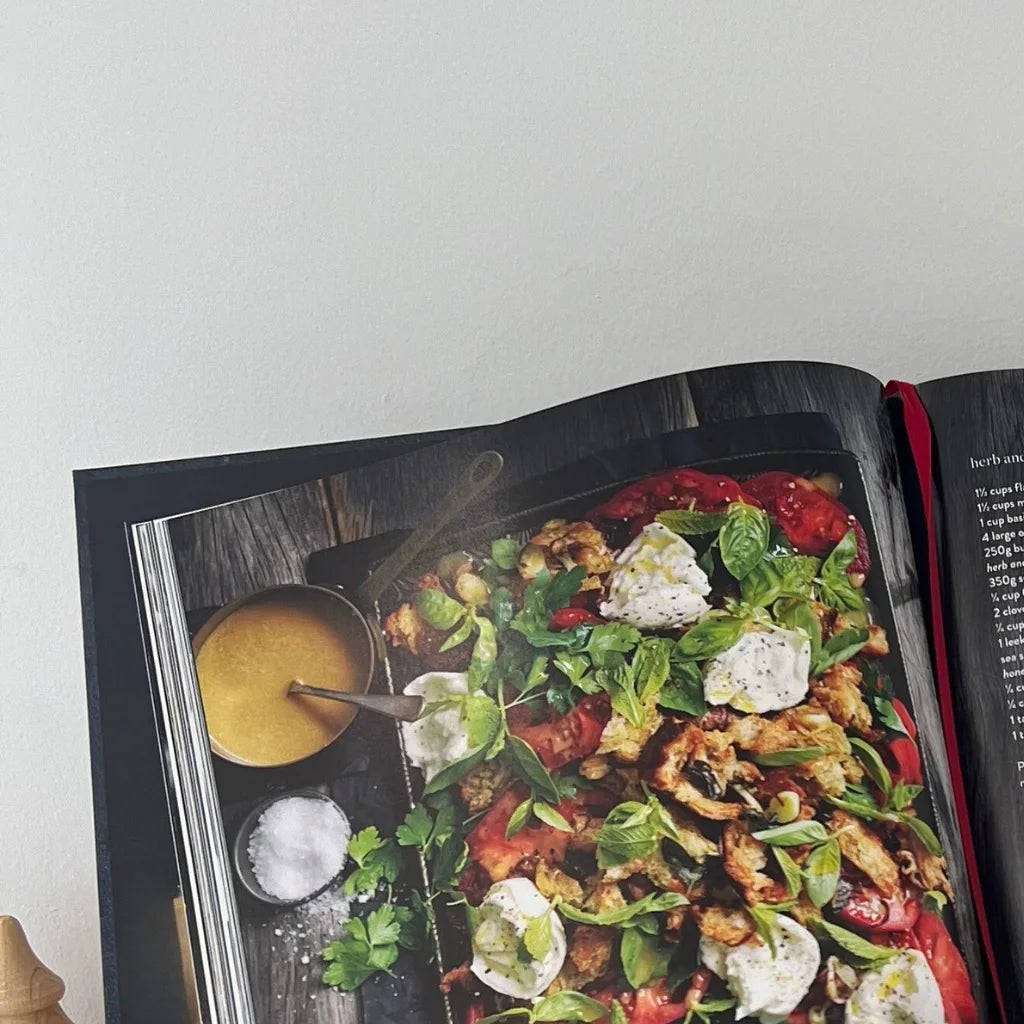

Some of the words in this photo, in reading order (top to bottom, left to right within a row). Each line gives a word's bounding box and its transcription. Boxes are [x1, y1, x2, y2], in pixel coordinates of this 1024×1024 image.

[971, 454, 1000, 469] herb
[980, 519, 984, 527] 1
[987, 517, 1005, 528] cup
[982, 534, 989, 542] 4
[992, 530, 1015, 542] large
[984, 547, 1012, 558] 250g
[987, 562, 1008, 572] herb
[989, 576, 1017, 588] 350g
[994, 609, 1000, 617] 2
[998, 639, 1002, 648] 1
[1001, 655, 1017, 663] sea
[1010, 715, 1015, 724] 1
[1012, 731, 1017, 740] 1
